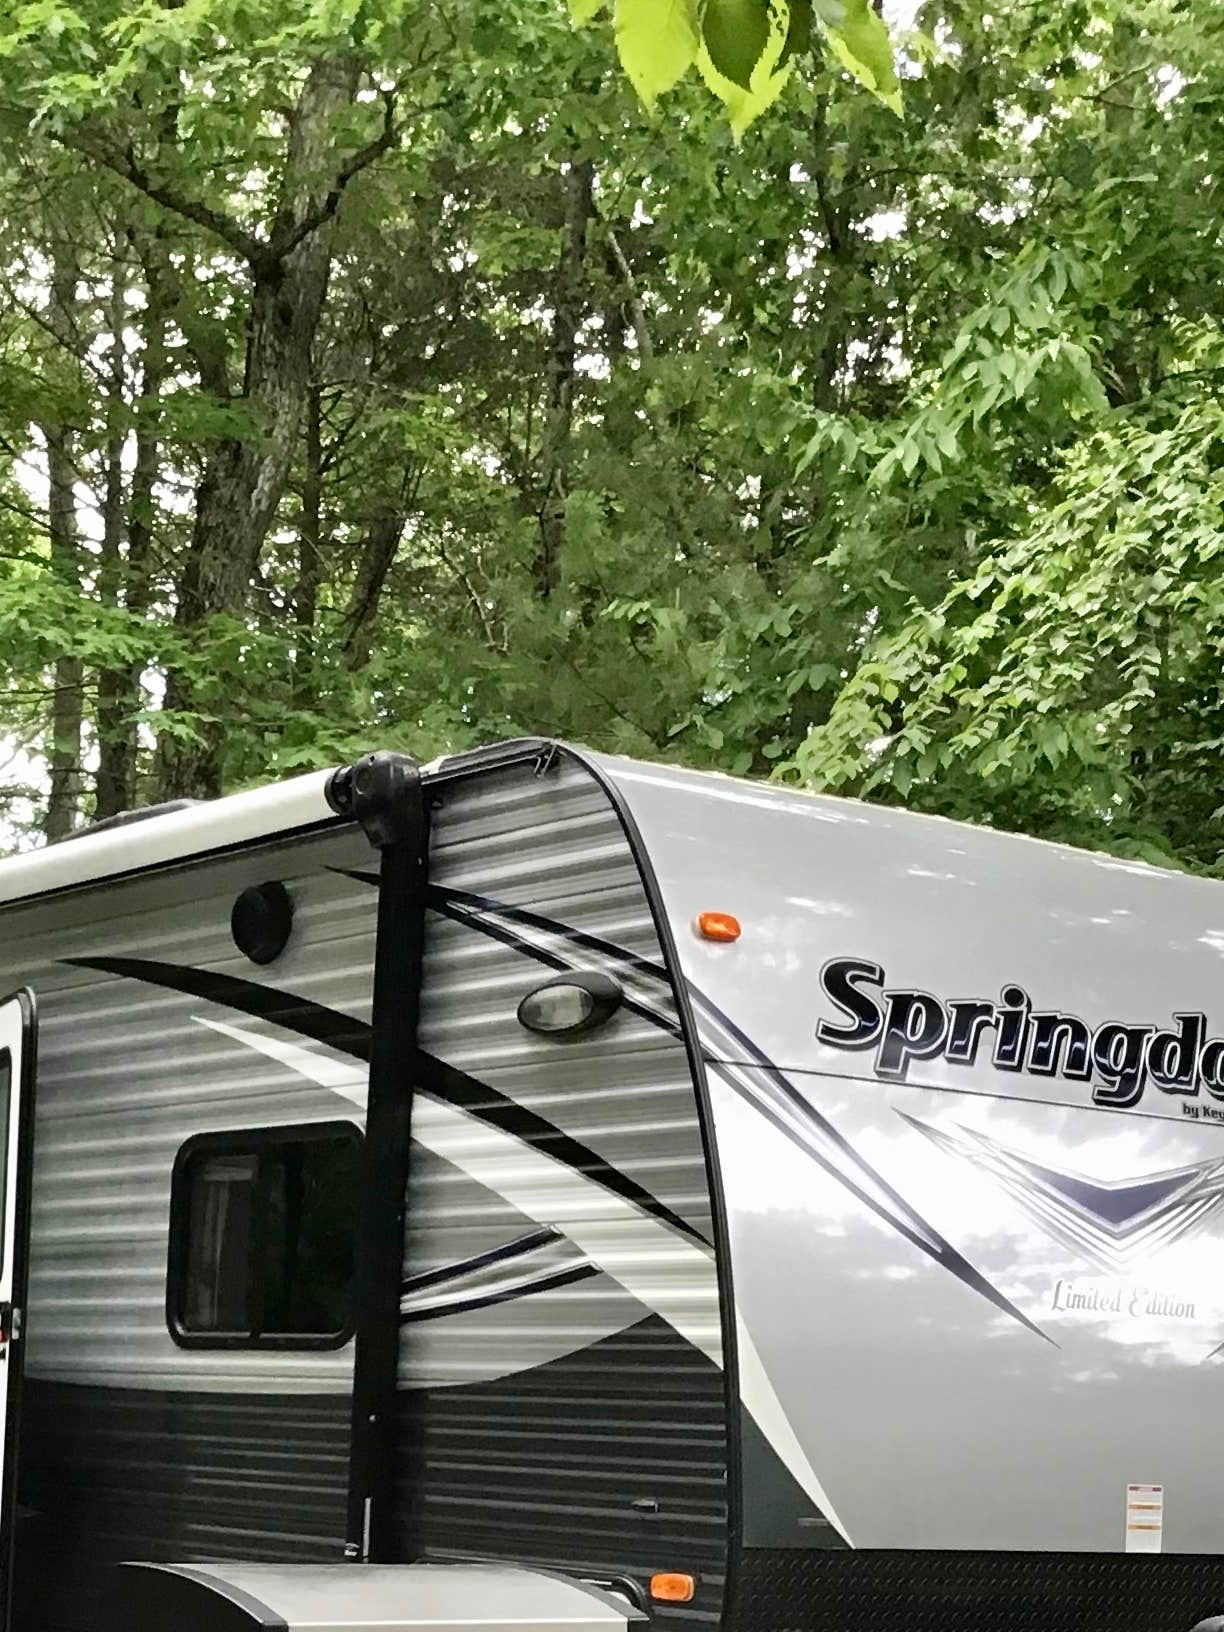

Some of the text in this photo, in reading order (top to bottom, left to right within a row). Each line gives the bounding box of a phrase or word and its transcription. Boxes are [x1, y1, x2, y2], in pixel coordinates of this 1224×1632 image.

[1182, 1102, 1199, 1119] by
[1051, 1279, 1195, 1318] Limited Edition
